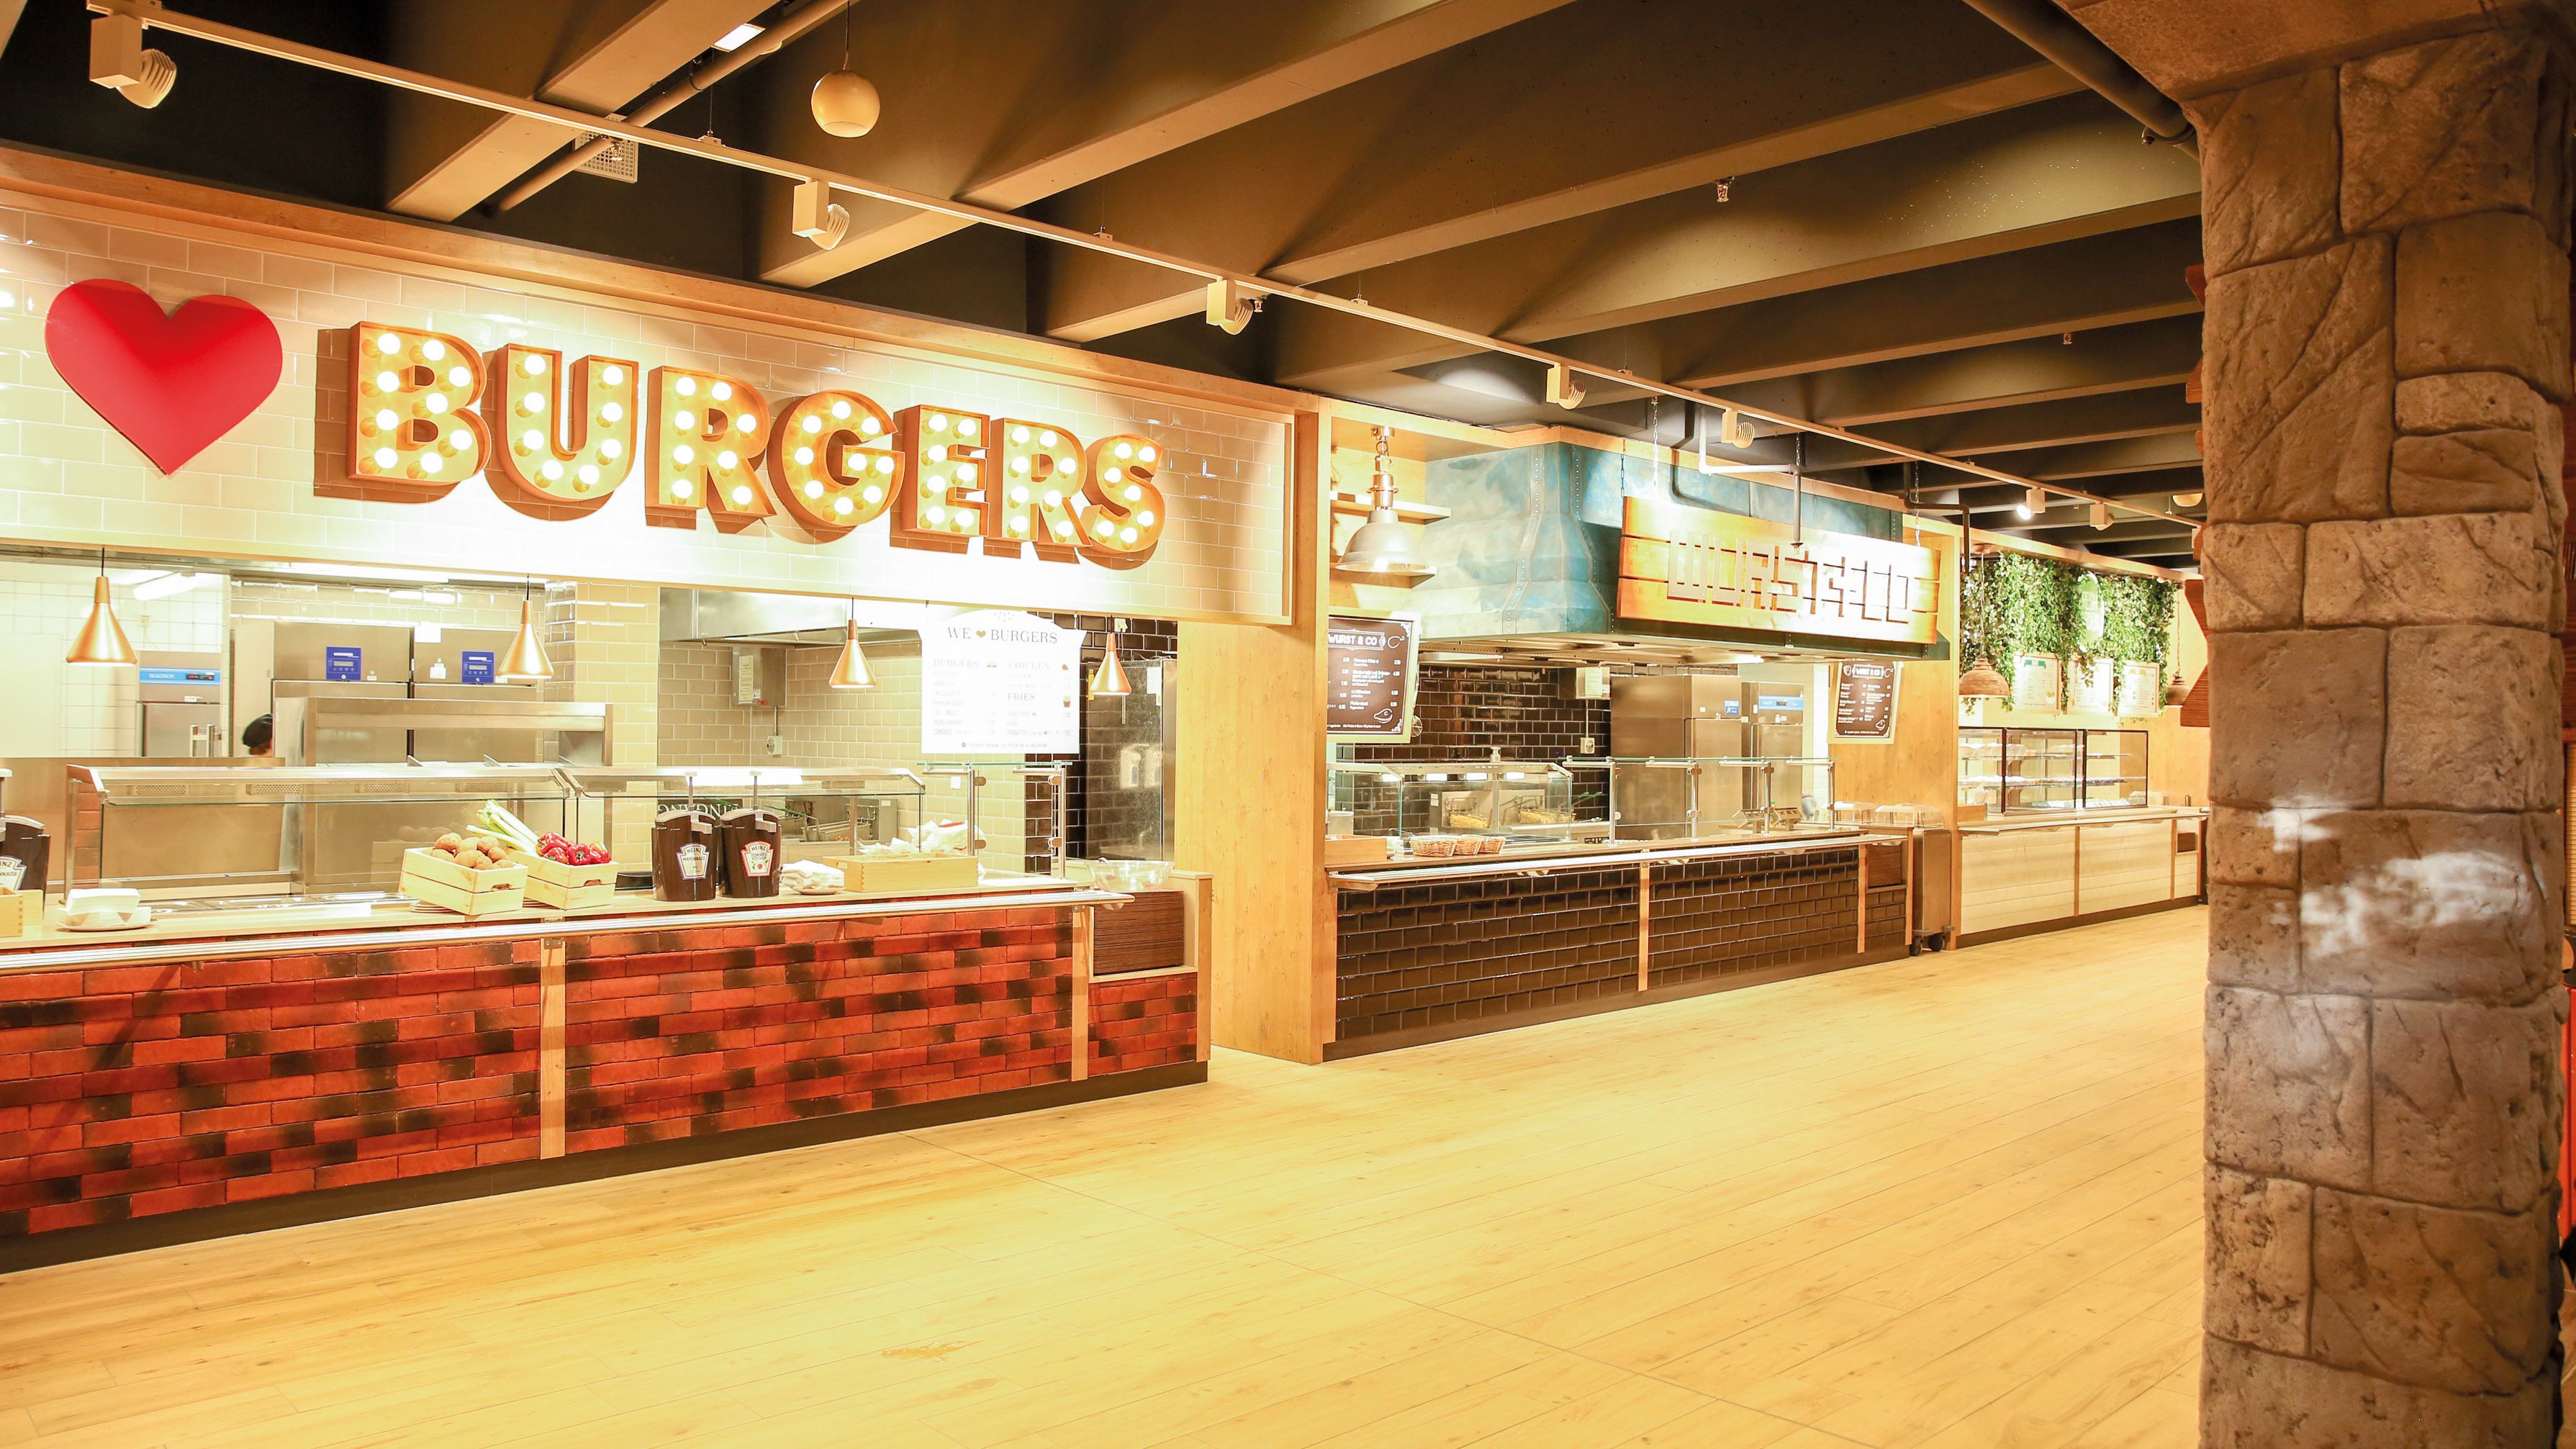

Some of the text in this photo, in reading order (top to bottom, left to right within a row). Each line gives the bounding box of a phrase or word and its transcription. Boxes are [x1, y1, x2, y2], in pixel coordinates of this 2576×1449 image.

[348, 321, 1165, 554] BURGERS
[948, 627, 1058, 644] WE BURGERS
[1328, 634, 1378, 646] WURST & CO
[934, 658, 979, 668] BURGERS
[1008, 661, 1050, 670] CHICKEN
